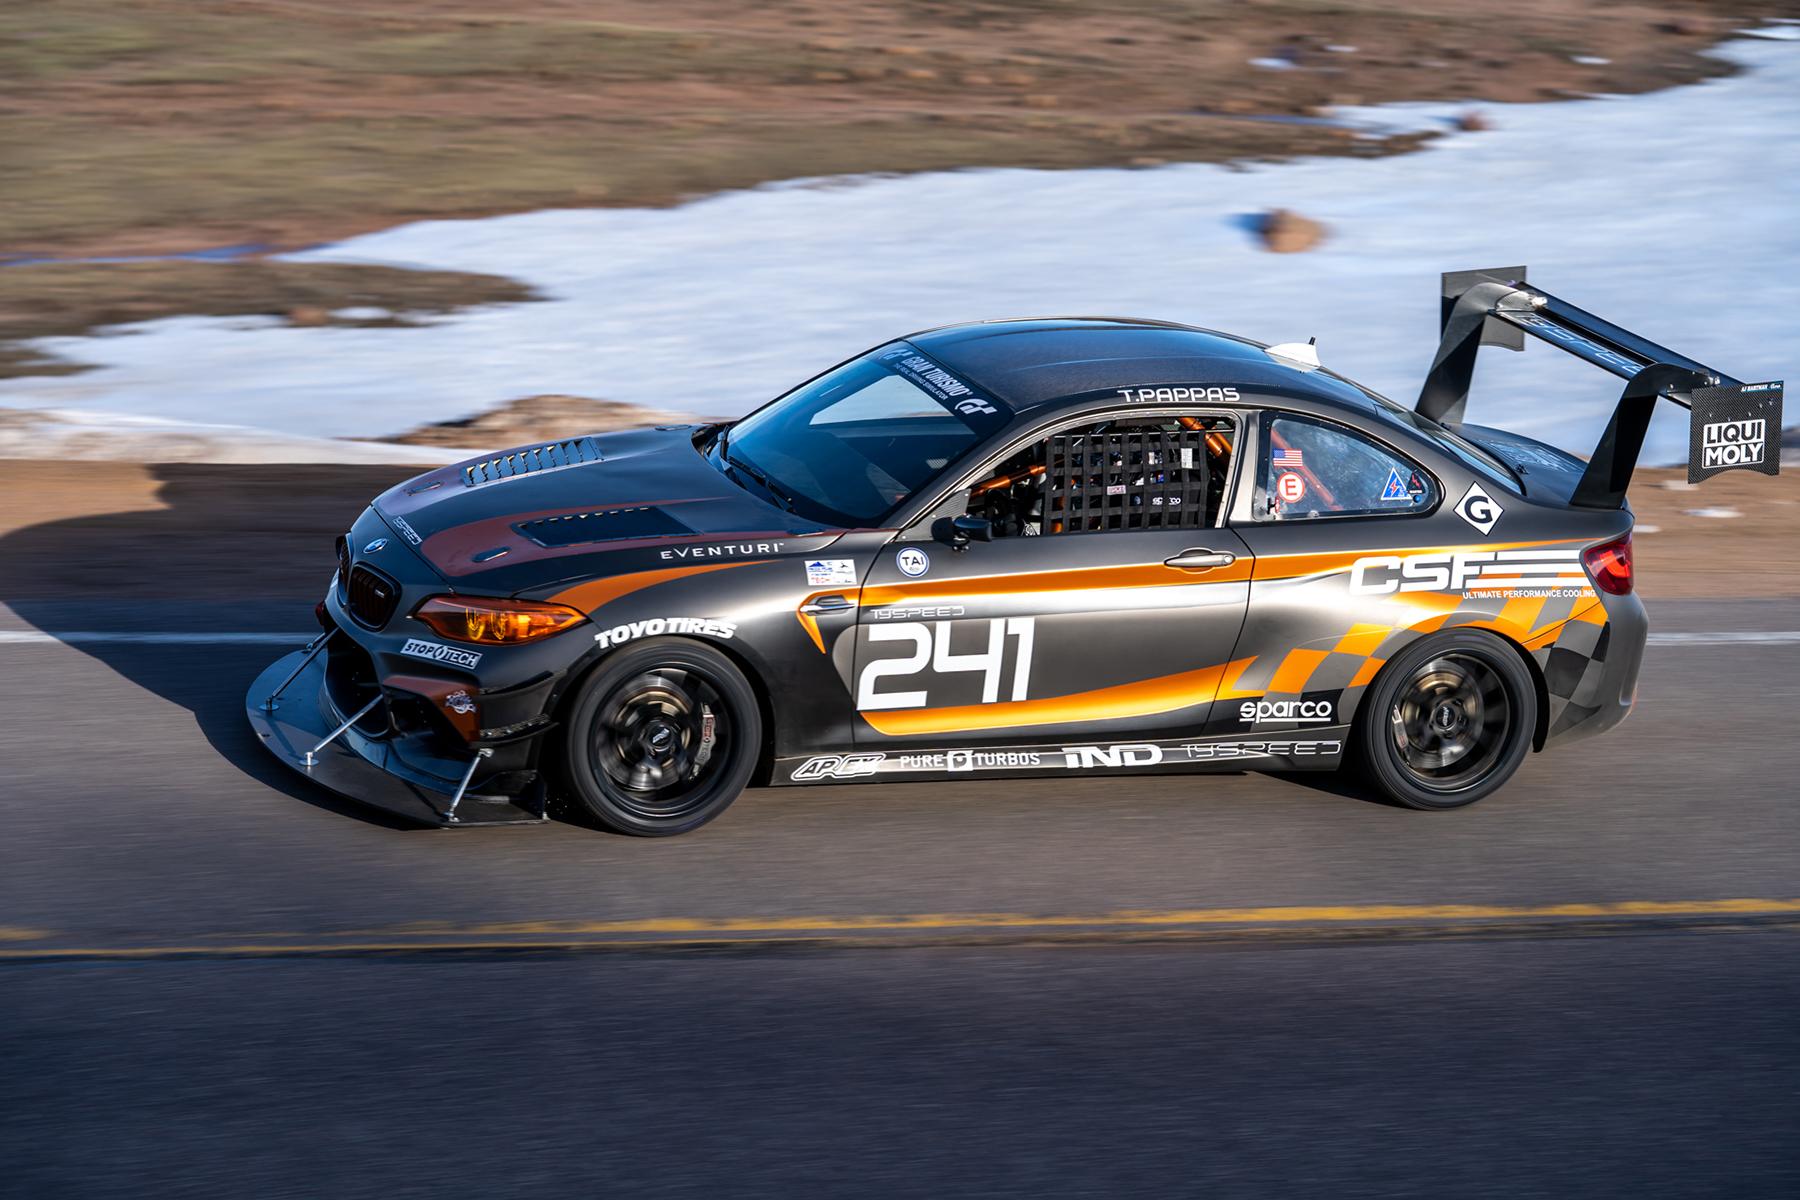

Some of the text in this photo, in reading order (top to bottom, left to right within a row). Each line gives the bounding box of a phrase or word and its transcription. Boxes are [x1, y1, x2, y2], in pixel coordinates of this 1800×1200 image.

[1117, 387, 1241, 403] T.PAPPAS
[1706, 422, 1762, 444] LIQUI
[1705, 443, 1763, 467] MOLY
[1284, 479, 1297, 496] E
[1464, 495, 1493, 524] G
[660, 543, 779, 560] EVENTURI
[1350, 551, 1495, 595] CSF
[1462, 589, 1596, 599] ULTIMATE PERFORMANCE COOLING
[856, 616, 1035, 711] 241
[1239, 701, 1332, 723] sparco
[900, 752, 1040, 768] PURE TURBOS
